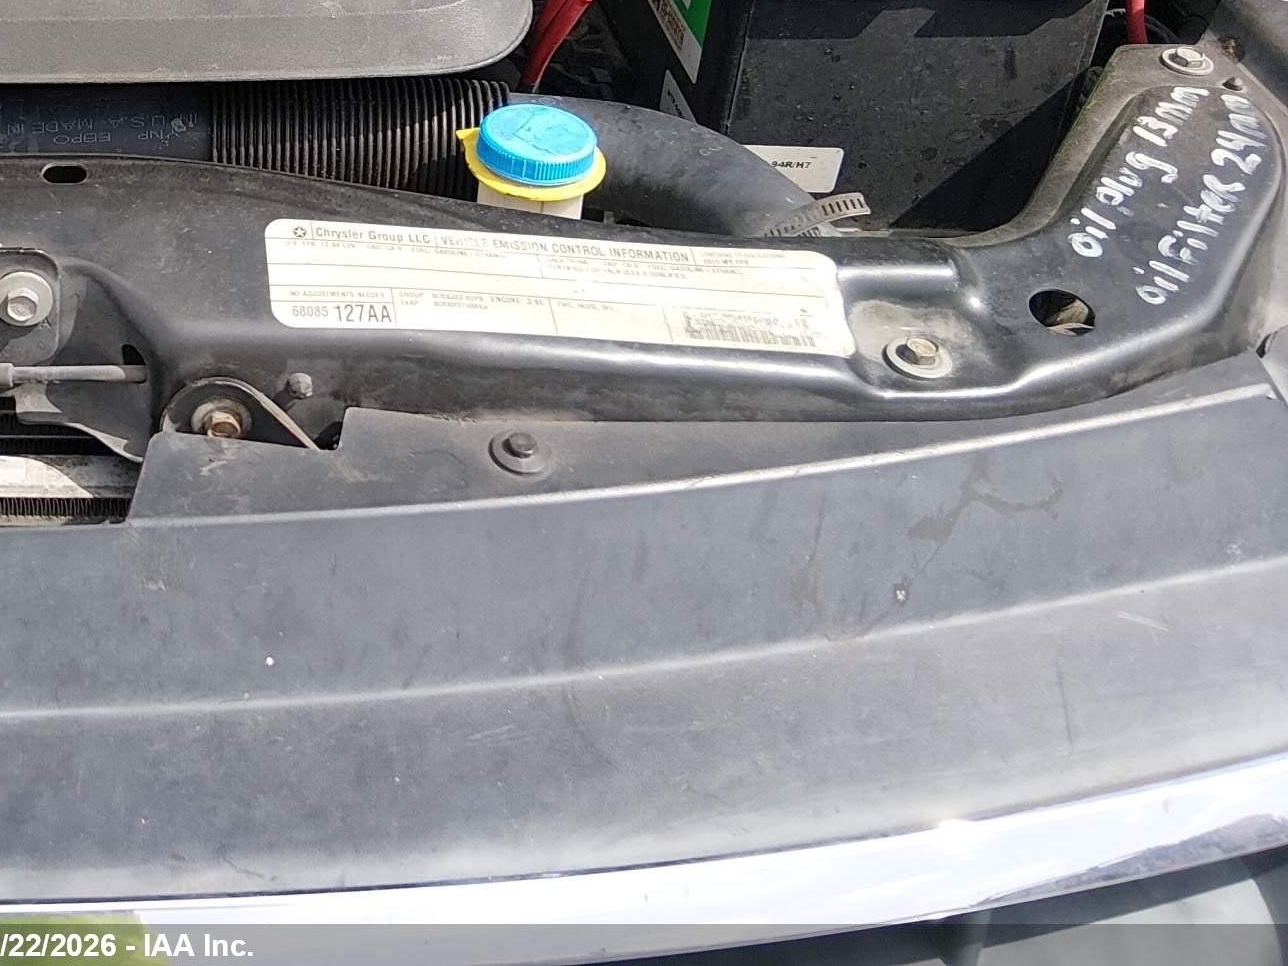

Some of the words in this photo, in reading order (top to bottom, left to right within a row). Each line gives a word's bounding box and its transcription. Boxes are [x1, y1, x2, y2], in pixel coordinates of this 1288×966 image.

[315, 227, 364, 241] Chrysler
[368, 231, 404, 244] Group
[409, 233, 431, 244] LLC
[492, 238, 549, 252] EMISSION
[552, 242, 606, 257] CONTROL
[609, 247, 690, 262] INFORMATION
[292, 305, 329, 318] 68085
[335, 303, 393, 323] 127AA
